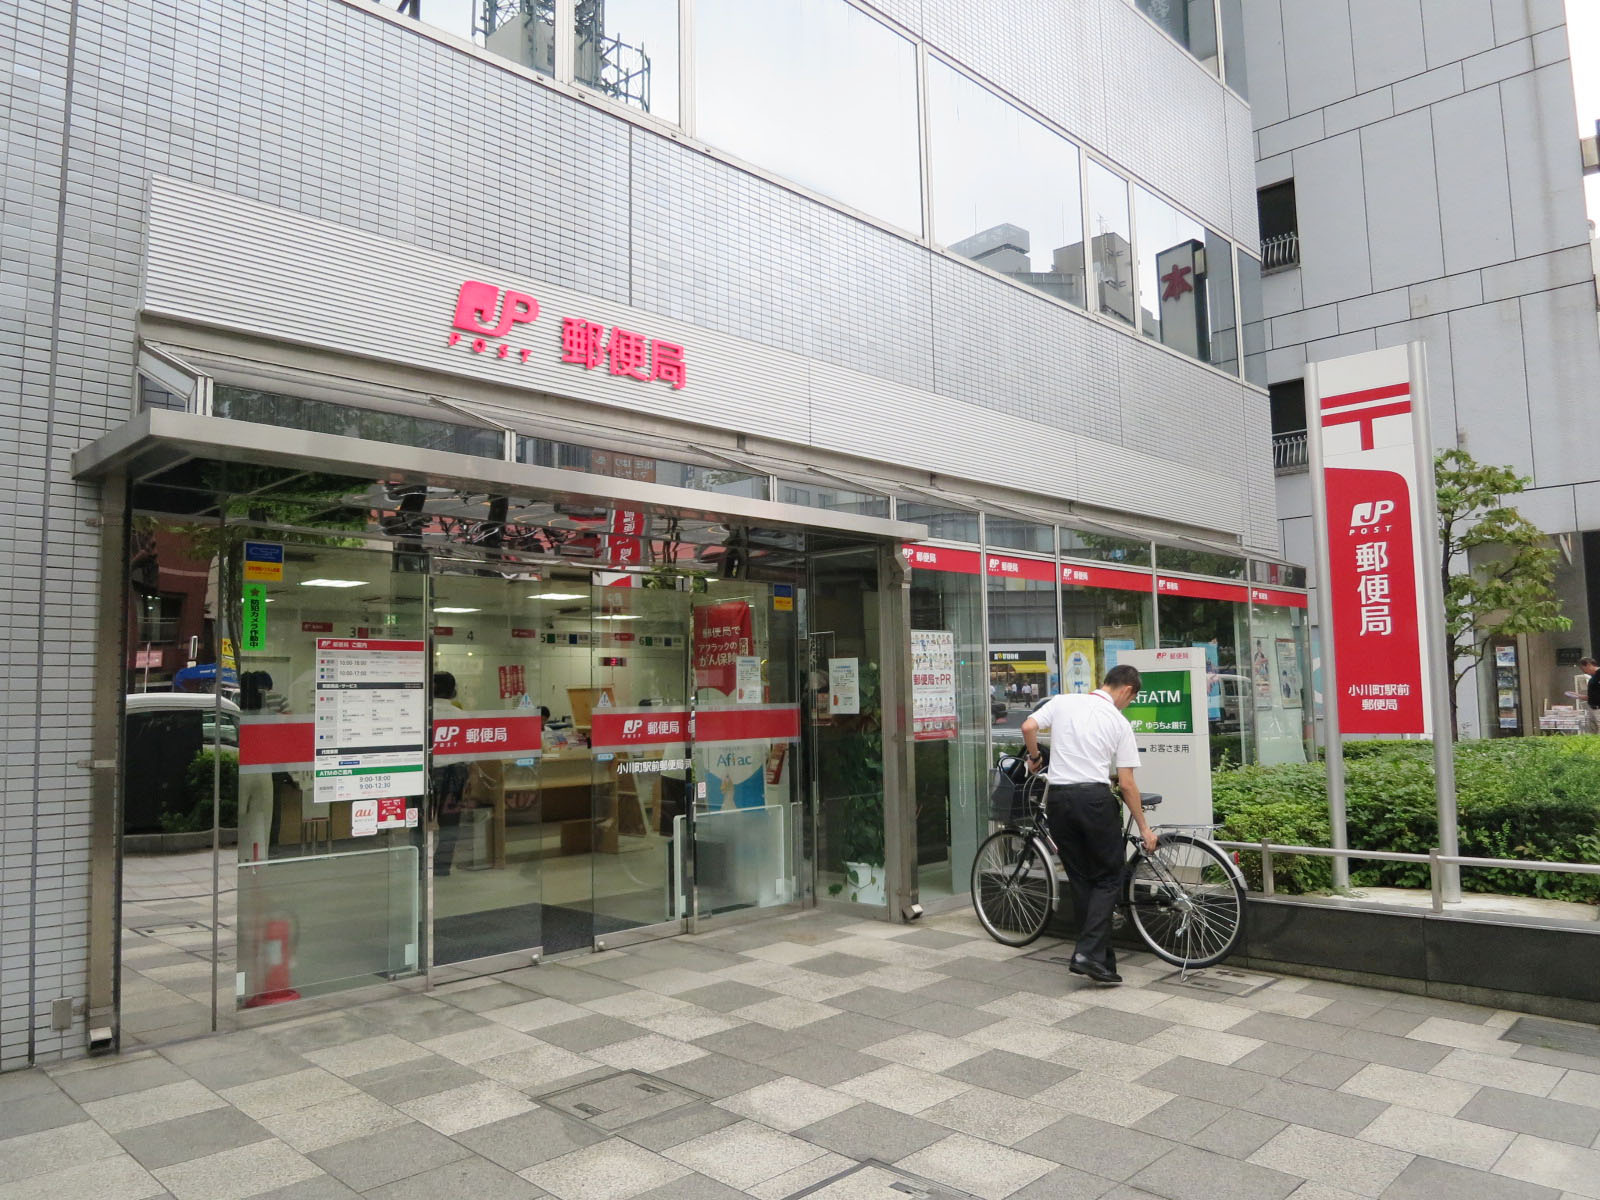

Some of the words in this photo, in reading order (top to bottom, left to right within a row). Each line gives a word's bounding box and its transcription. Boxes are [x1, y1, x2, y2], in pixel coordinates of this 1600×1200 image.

[448, 332, 533, 363] POST
[561, 316, 687, 391] 郵便局
[1350, 500, 1395, 527] JP
[1349, 525, 1392, 536] POST
[916, 551, 937, 564] 郵便局
[1001, 561, 1019, 573] 郵便局
[1356, 541, 1392, 636] 郵便局
[249, 599, 260, 648] 防犯カメラ作動中
[350, 627, 356, 638] 3
[466, 630, 474, 641] 4
[541, 633, 546, 643] 5
[702, 626, 741, 639] 郵便局で
[639, 636, 645, 646] 6
[698, 641, 738, 653] アフラックの
[1169, 652, 1189, 660] 郵便局
[913, 673, 952, 686] 郵便局でPR
[1130, 690, 1181, 704] 行ATM
[1348, 684, 1410, 697] 小川町駅前
[1361, 698, 1398, 711] 郵便局
[647, 720, 680, 735] 郵便局
[1145, 721, 1187, 730] ゆうちょ銀行
[466, 728, 508, 743] 郵便局
[1149, 744, 1190, 753] お客さま用
[716, 752, 753, 767] Aflac
[319, 769, 353, 777] ATMのご案内
[616, 759, 685, 775] 小川町駅前郵便局
[359, 775, 391, 783] 9:00-18:00
[359, 782, 391, 790] 9:00-12:30
[354, 808, 373, 818] au
